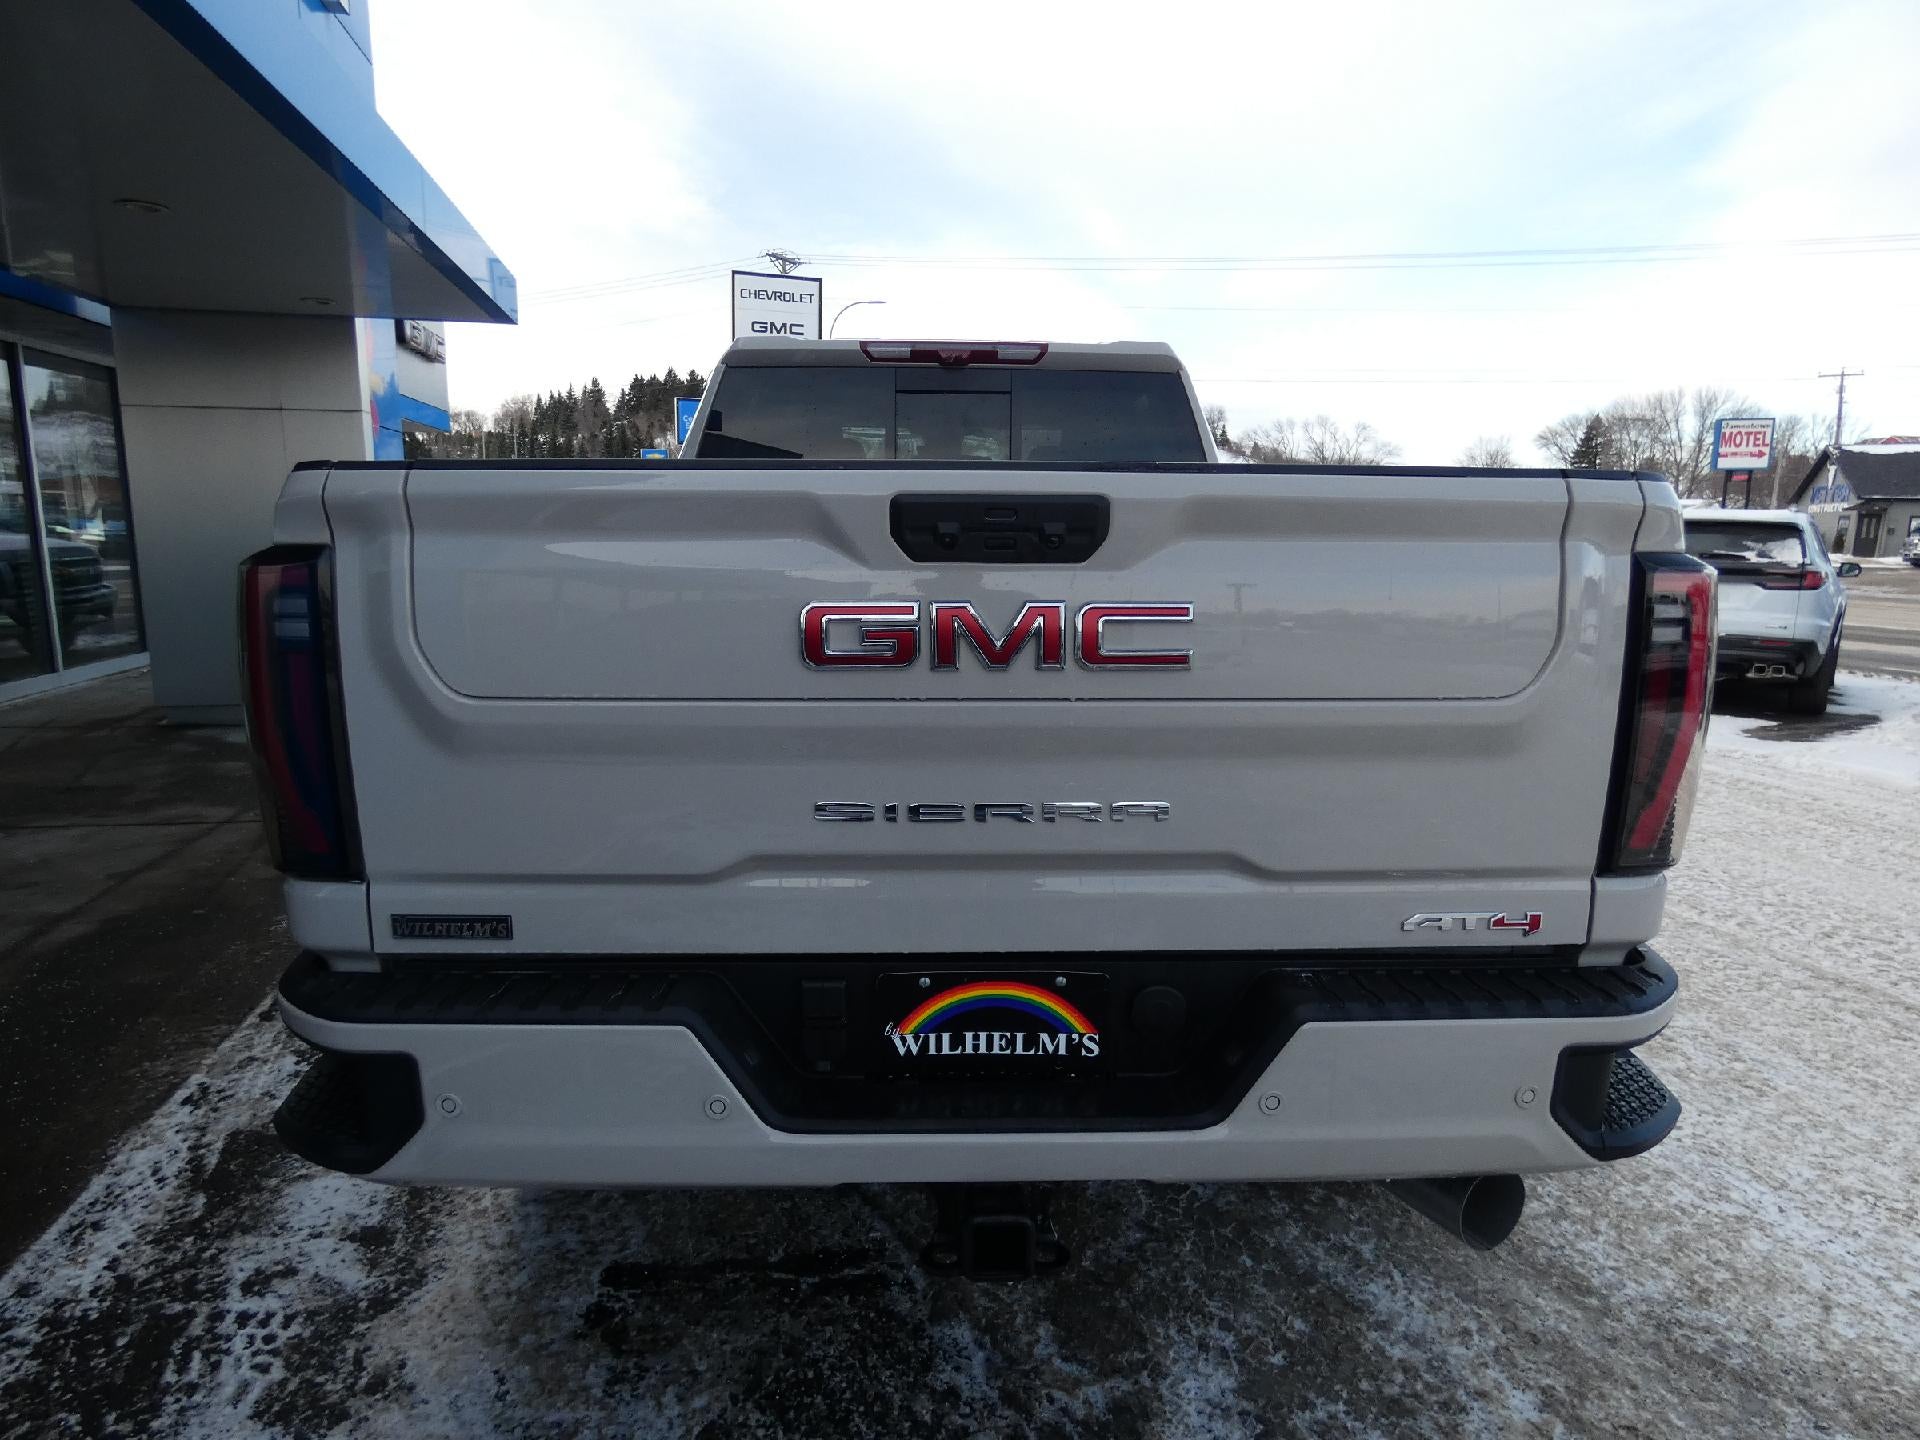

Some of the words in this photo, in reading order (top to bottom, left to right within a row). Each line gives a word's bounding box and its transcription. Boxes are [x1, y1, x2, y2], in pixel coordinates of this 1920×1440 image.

[740, 288, 815, 304] CHEVROLET
[750, 320, 804, 335] GMC
[1720, 431, 1769, 448] MOTEL
[800, 601, 1194, 671] GMC
[814, 801, 1170, 823] SIERRA
[394, 917, 507, 937] WILHELM'S
[1402, 911, 1542, 936] AT4
[893, 1031, 1099, 1056] WILHELM'S
